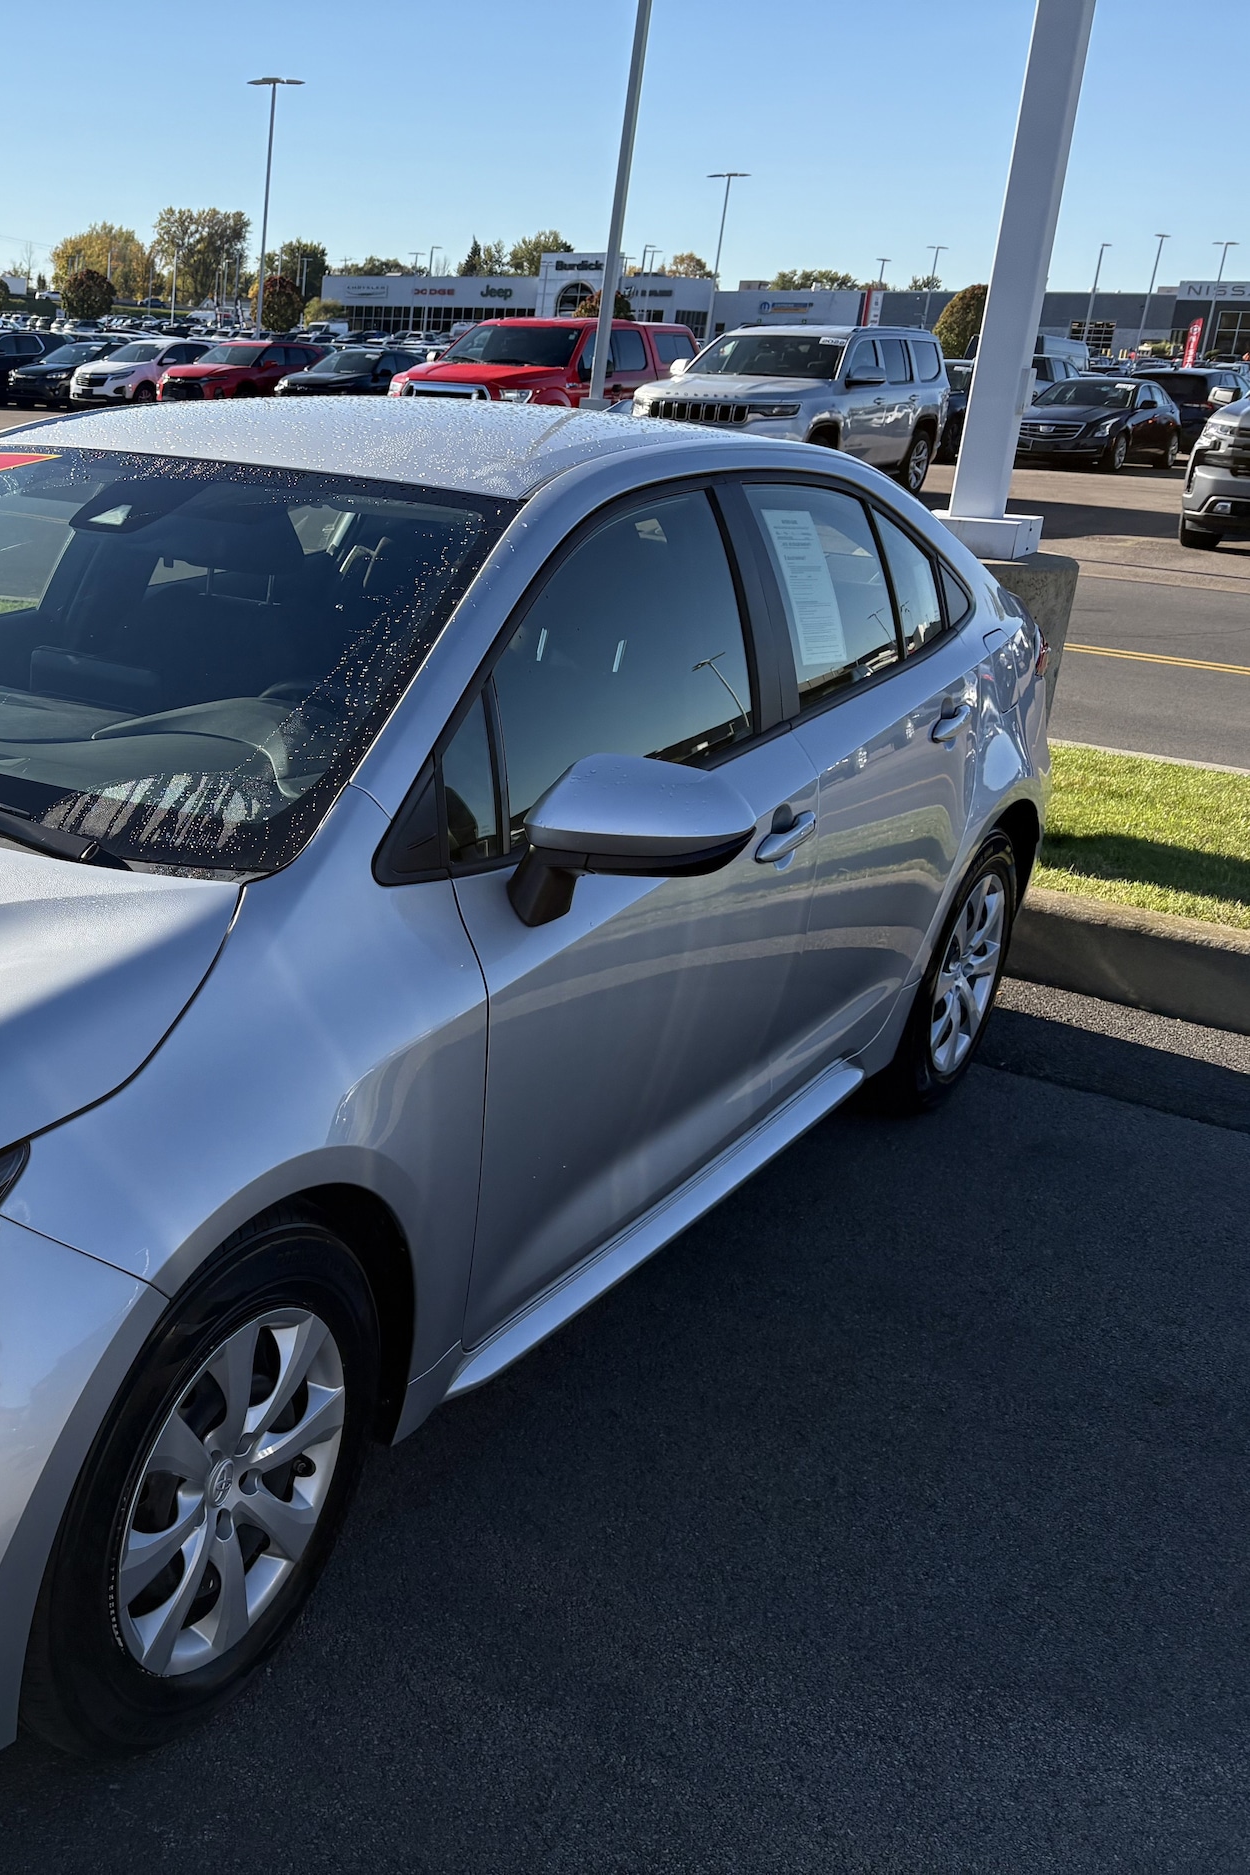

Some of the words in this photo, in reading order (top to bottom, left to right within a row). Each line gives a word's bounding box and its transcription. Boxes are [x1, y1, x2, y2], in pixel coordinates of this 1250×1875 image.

[555, 260, 604, 271] Burdick
[480, 284, 512, 300] Jeep
[1187, 285, 1250, 296] NISS
